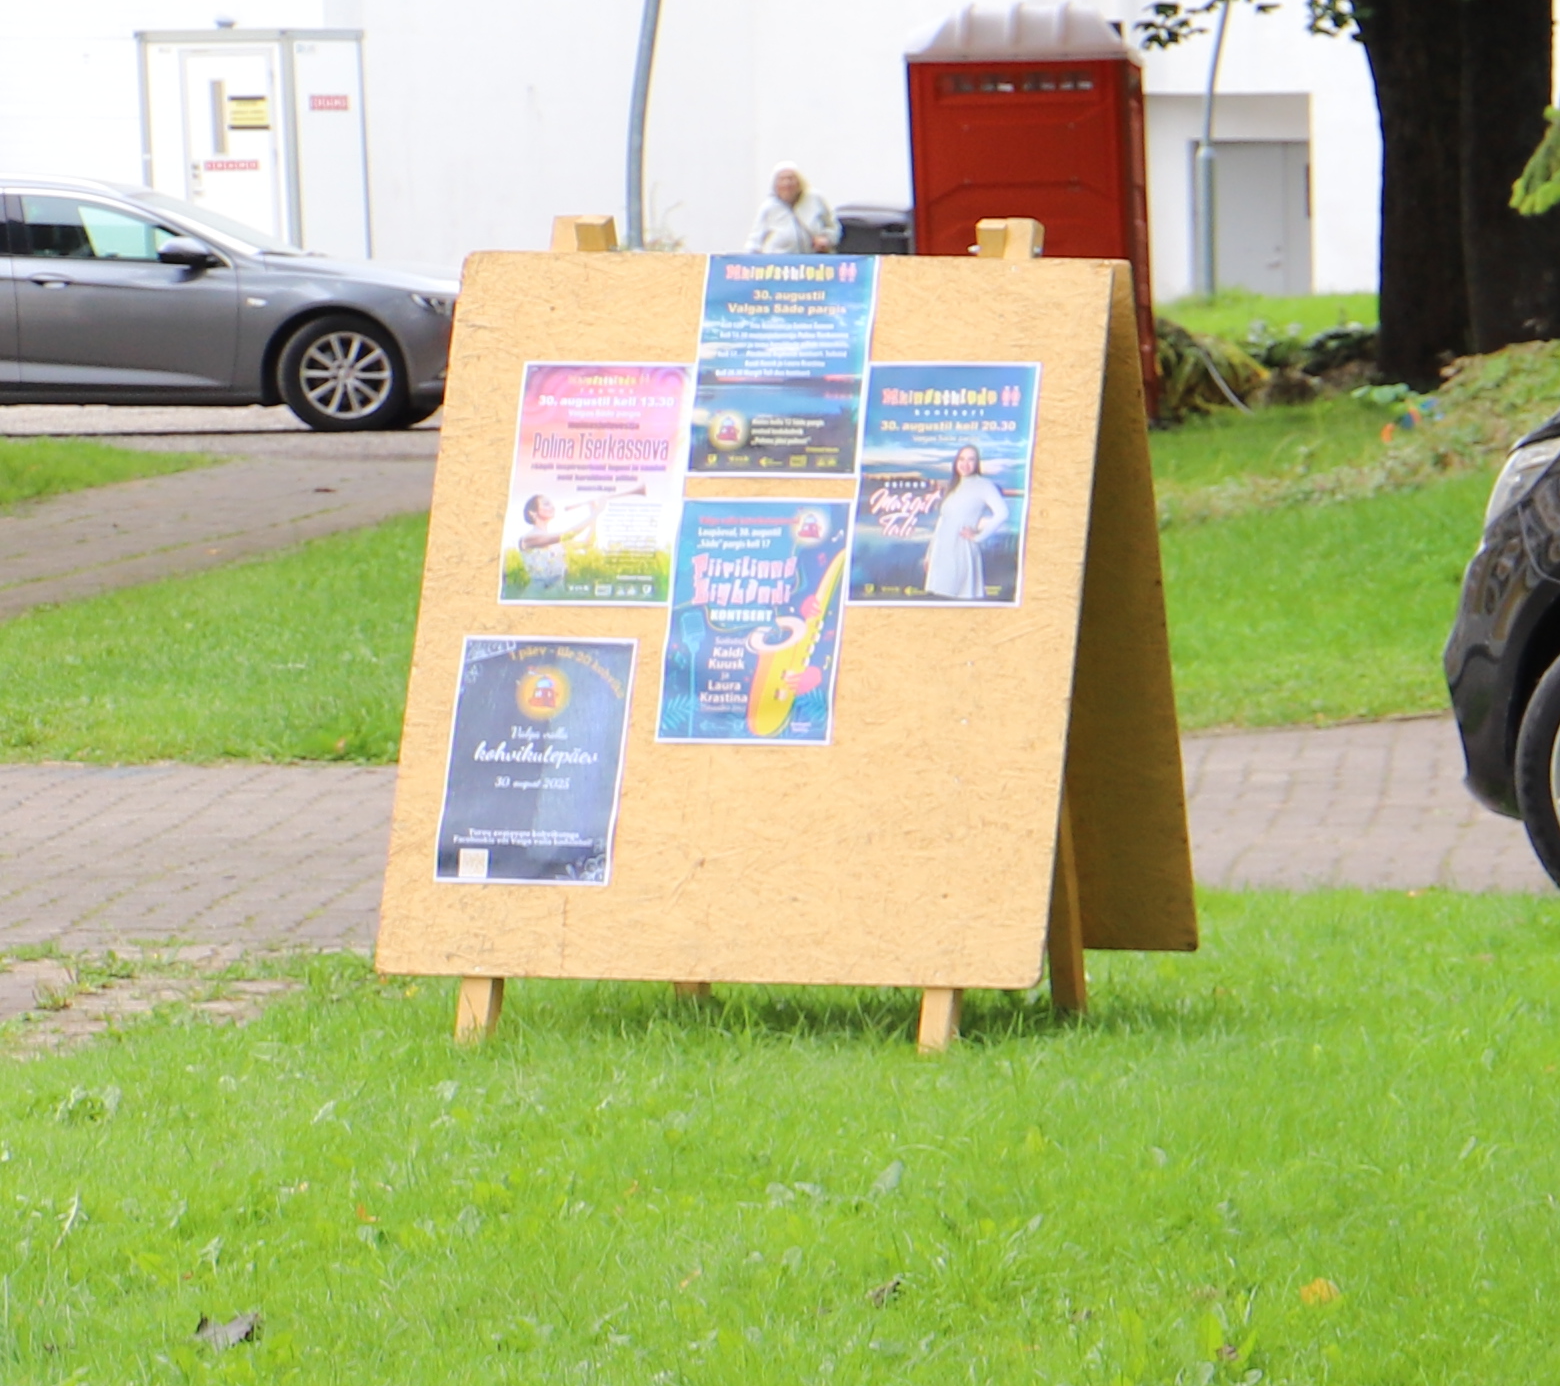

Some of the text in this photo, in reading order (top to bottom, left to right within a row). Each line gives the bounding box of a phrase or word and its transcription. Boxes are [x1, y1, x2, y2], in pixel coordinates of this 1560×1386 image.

[753, 289, 825, 303] 30. augustil
[727, 302, 770, 315] Valgas
[807, 304, 847, 316] pargis
[538, 394, 675, 408] 30. augustil kell 13.30
[880, 420, 1017, 433] 30. augustil kell 20.30
[532, 432, 669, 461] Polina Tšerkassova
[869, 488, 942, 514] Margit
[879, 513, 918, 537] Tali
[710, 609, 773, 622] KONTSERT
[518, 645, 548, 661] päev
[712, 647, 744, 658] Kaidi
[708, 658, 745, 670] Kuusk
[708, 679, 742, 691] Laura
[700, 691, 748, 703] Krastina
[474, 740, 598, 769] kohvikutepäev
[494, 775, 511, 789] 30
[542, 776, 571, 790] 2025
